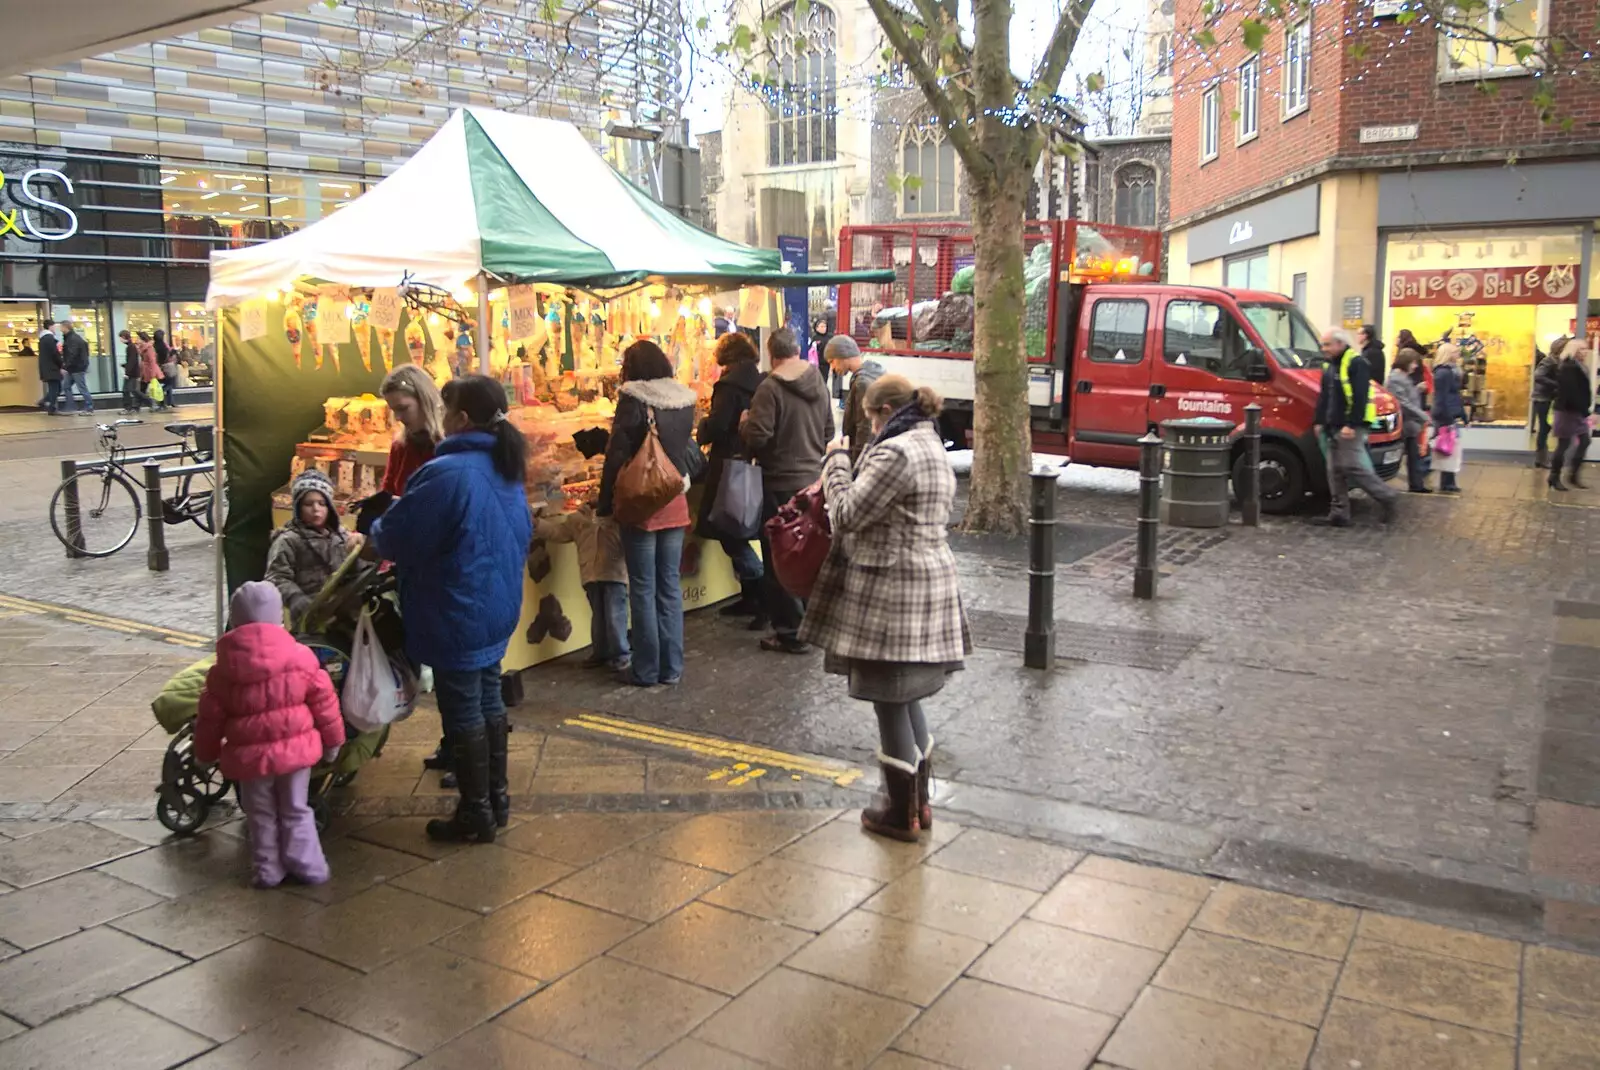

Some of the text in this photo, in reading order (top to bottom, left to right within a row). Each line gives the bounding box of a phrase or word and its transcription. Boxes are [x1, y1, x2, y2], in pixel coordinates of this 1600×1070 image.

[1365, 128, 1395, 140] BRIGG
[513, 307, 534, 321] MIX
[1178, 398, 1233, 414] fountains
[682, 585, 707, 603] dge
